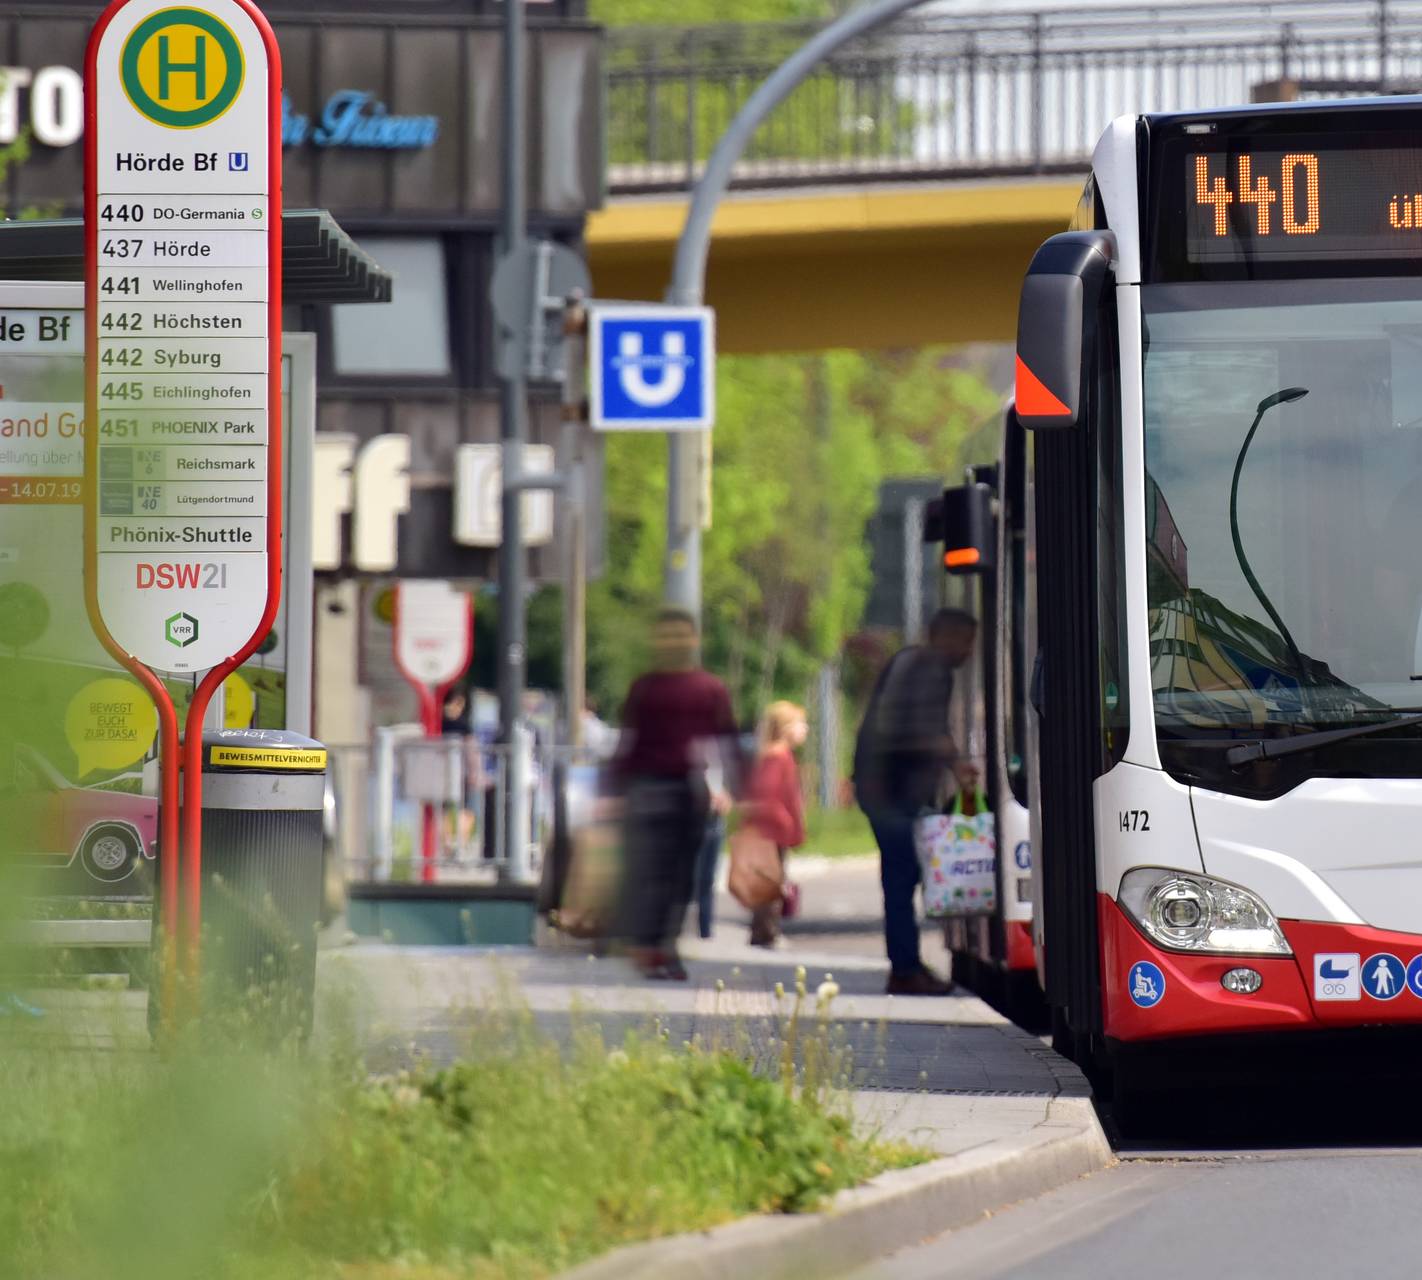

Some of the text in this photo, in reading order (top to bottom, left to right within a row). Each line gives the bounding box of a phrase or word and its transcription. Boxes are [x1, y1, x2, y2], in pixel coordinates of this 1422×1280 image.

[116, 153, 185, 171] Hörde
[194, 153, 218, 171] Bf
[1195, 153, 1319, 236] 440
[101, 204, 144, 222] 440
[153, 208, 245, 219] DO-Germania
[103, 239, 211, 258] 437 Hörde
[101, 277, 243, 295] 441 Wellinghofen
[39, 316, 70, 341] Bf
[101, 313, 242, 331] 442 Höchsten
[101, 348, 221, 368] 442 Syburg
[101, 382, 251, 400] 445 Eichlinghofen
[101, 419, 255, 437] 451 PHOENIX Park
[176, 458, 256, 470] Reichsmark
[11, 483, 81, 497] 14.07.19
[142, 498, 157, 510] 40
[176, 495, 254, 506] Lütgendortmund
[111, 527, 252, 543] Phönix-Shuttle
[136, 563, 227, 589] DSW21
[173, 626, 192, 634] VRR
[89, 702, 135, 713] BEWEGT
[97, 715, 125, 726] EUCH
[219, 752, 321, 764] BEWEISMITTELVERNICHTER
[1119, 810, 1150, 832] 1472
